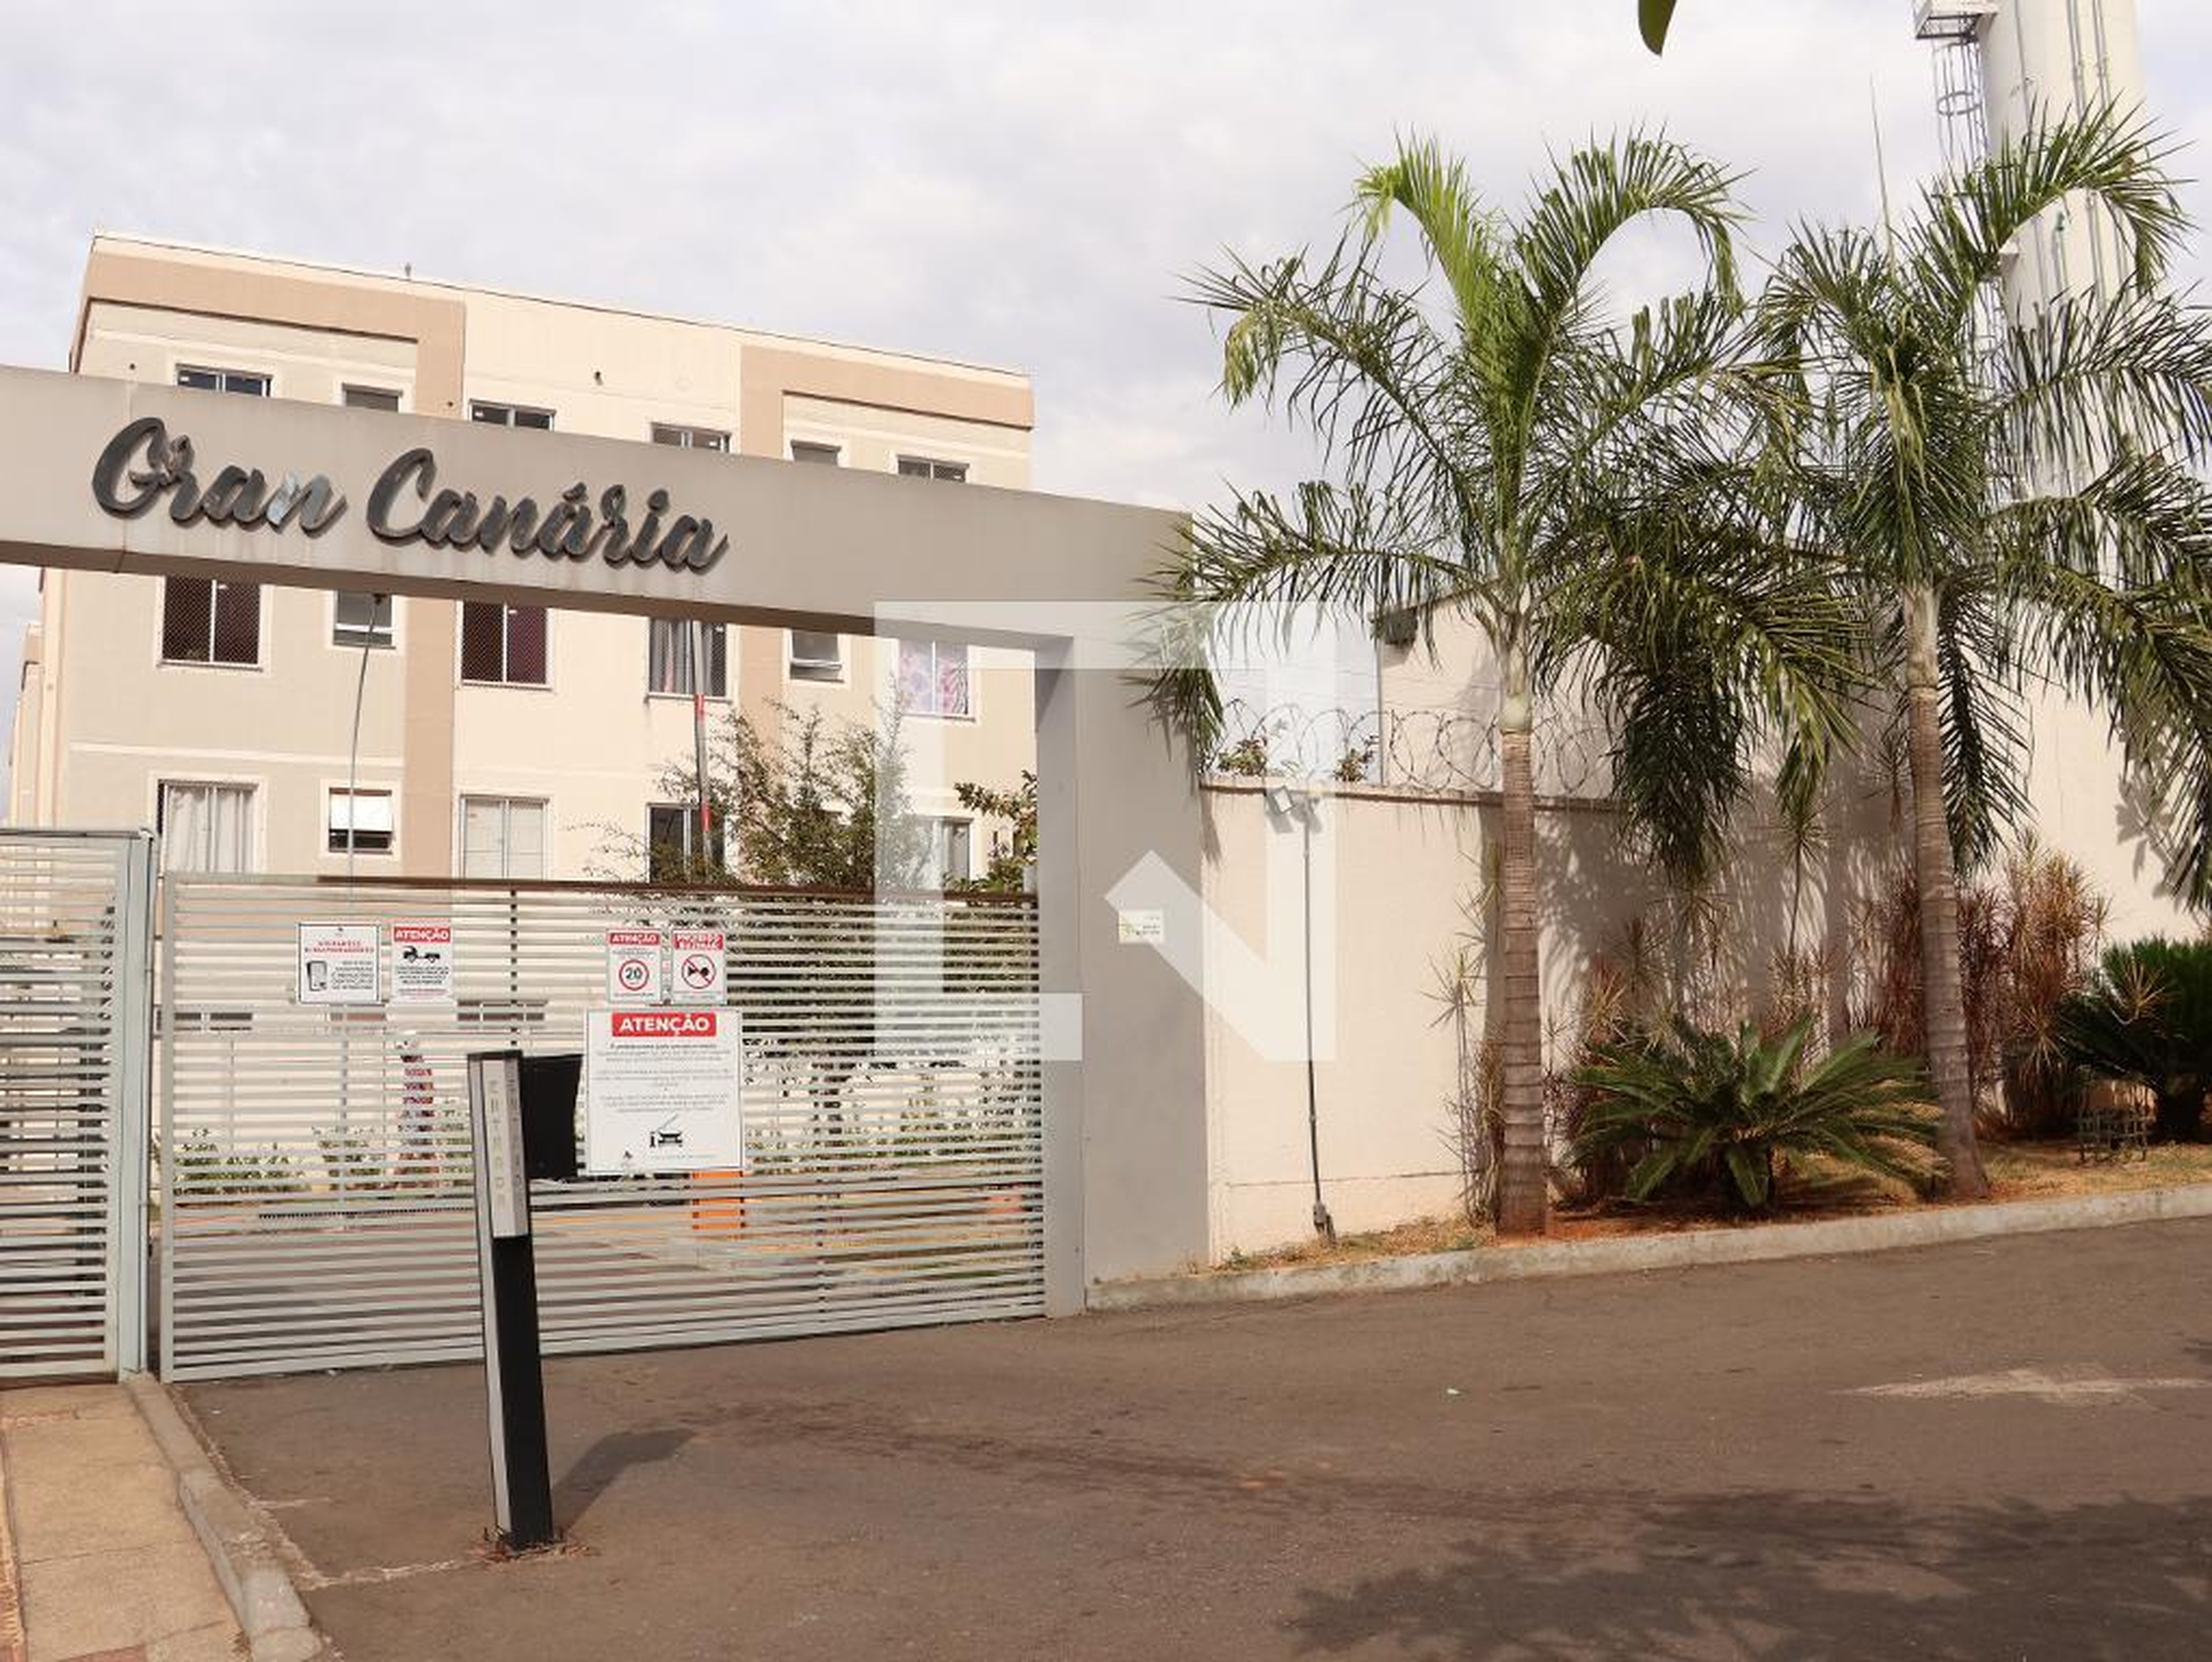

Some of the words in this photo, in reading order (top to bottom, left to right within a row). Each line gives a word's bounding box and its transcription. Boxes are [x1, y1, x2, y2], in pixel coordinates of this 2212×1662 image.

[92, 416, 347, 539] Gran
[366, 447, 729, 574] Canária
[395, 928, 449, 943] ATENÇÃO
[625, 966, 643, 980] 20
[619, 1014, 710, 1035] ATENÇÃO
